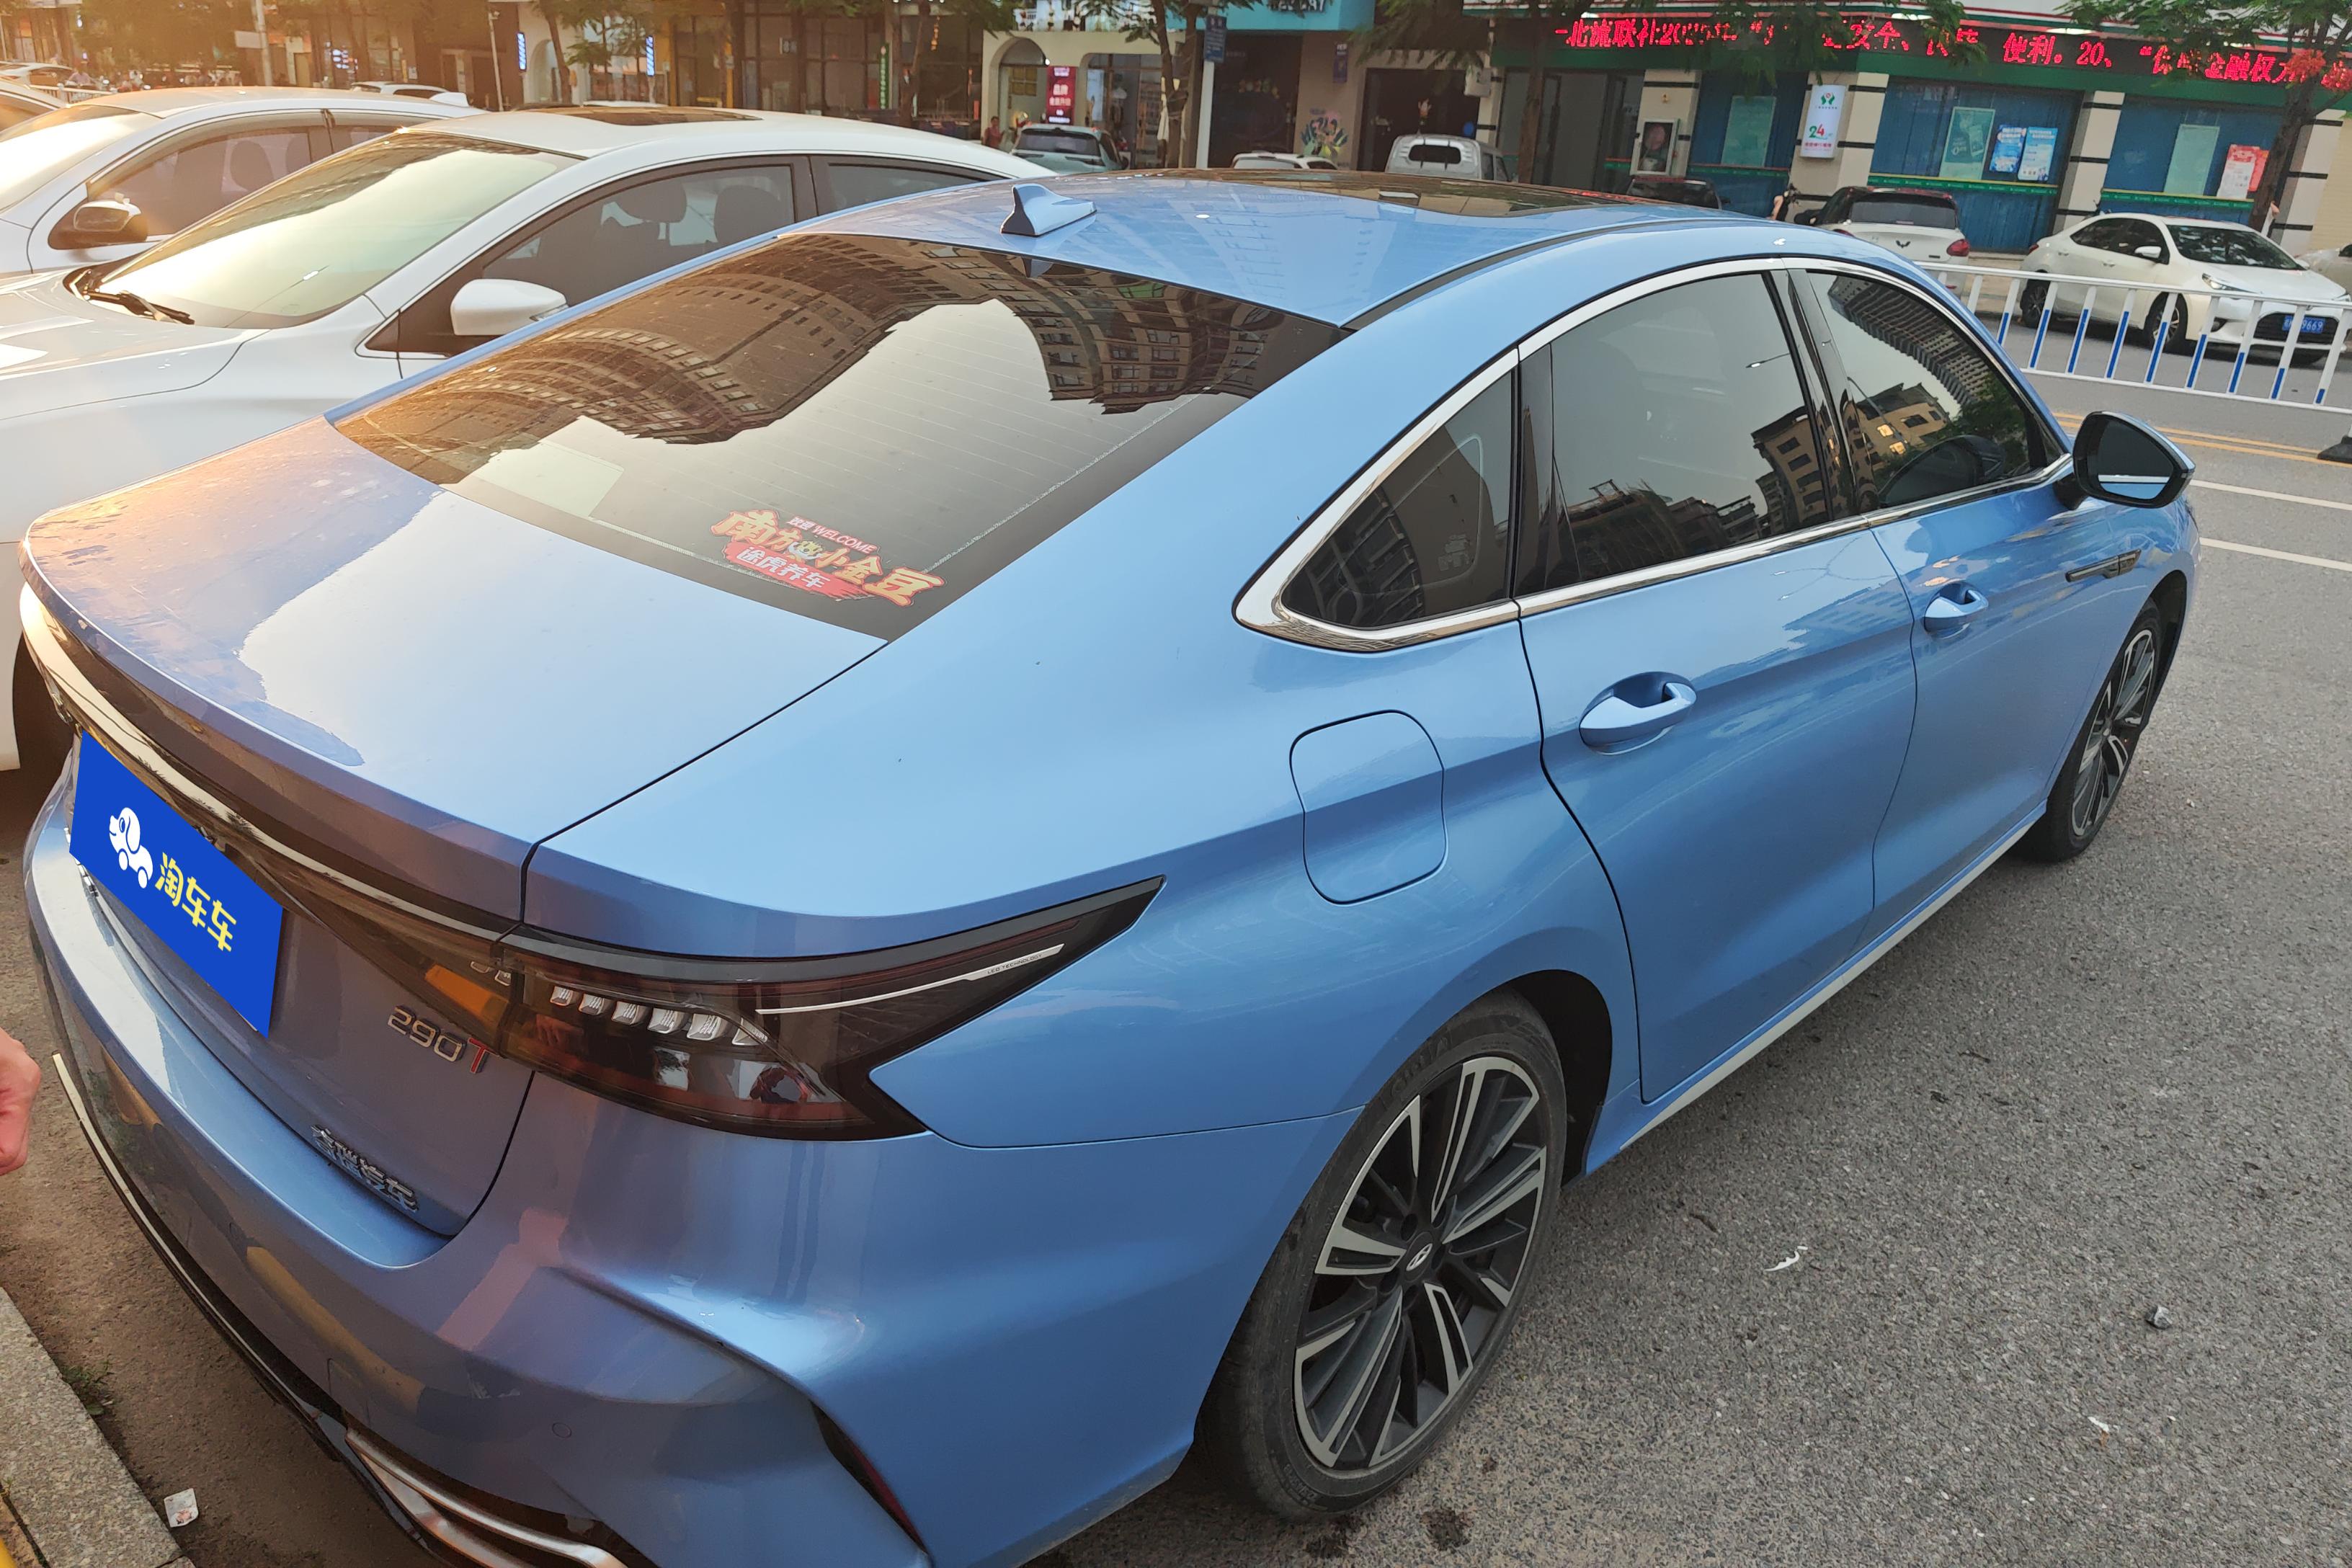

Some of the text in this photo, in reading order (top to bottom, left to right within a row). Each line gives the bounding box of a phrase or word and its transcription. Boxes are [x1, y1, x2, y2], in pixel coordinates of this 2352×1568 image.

[1809, 124, 1825, 138] 24
[786, 516, 878, 554] 欢迎 WELCOME
[736, 546, 831, 589] 途虎养车
[1002, 954, 1042, 968] TECHNOLOGY
[388, 1006, 499, 1074] 290T
[311, 1125, 418, 1213] 奇瑞汽车
